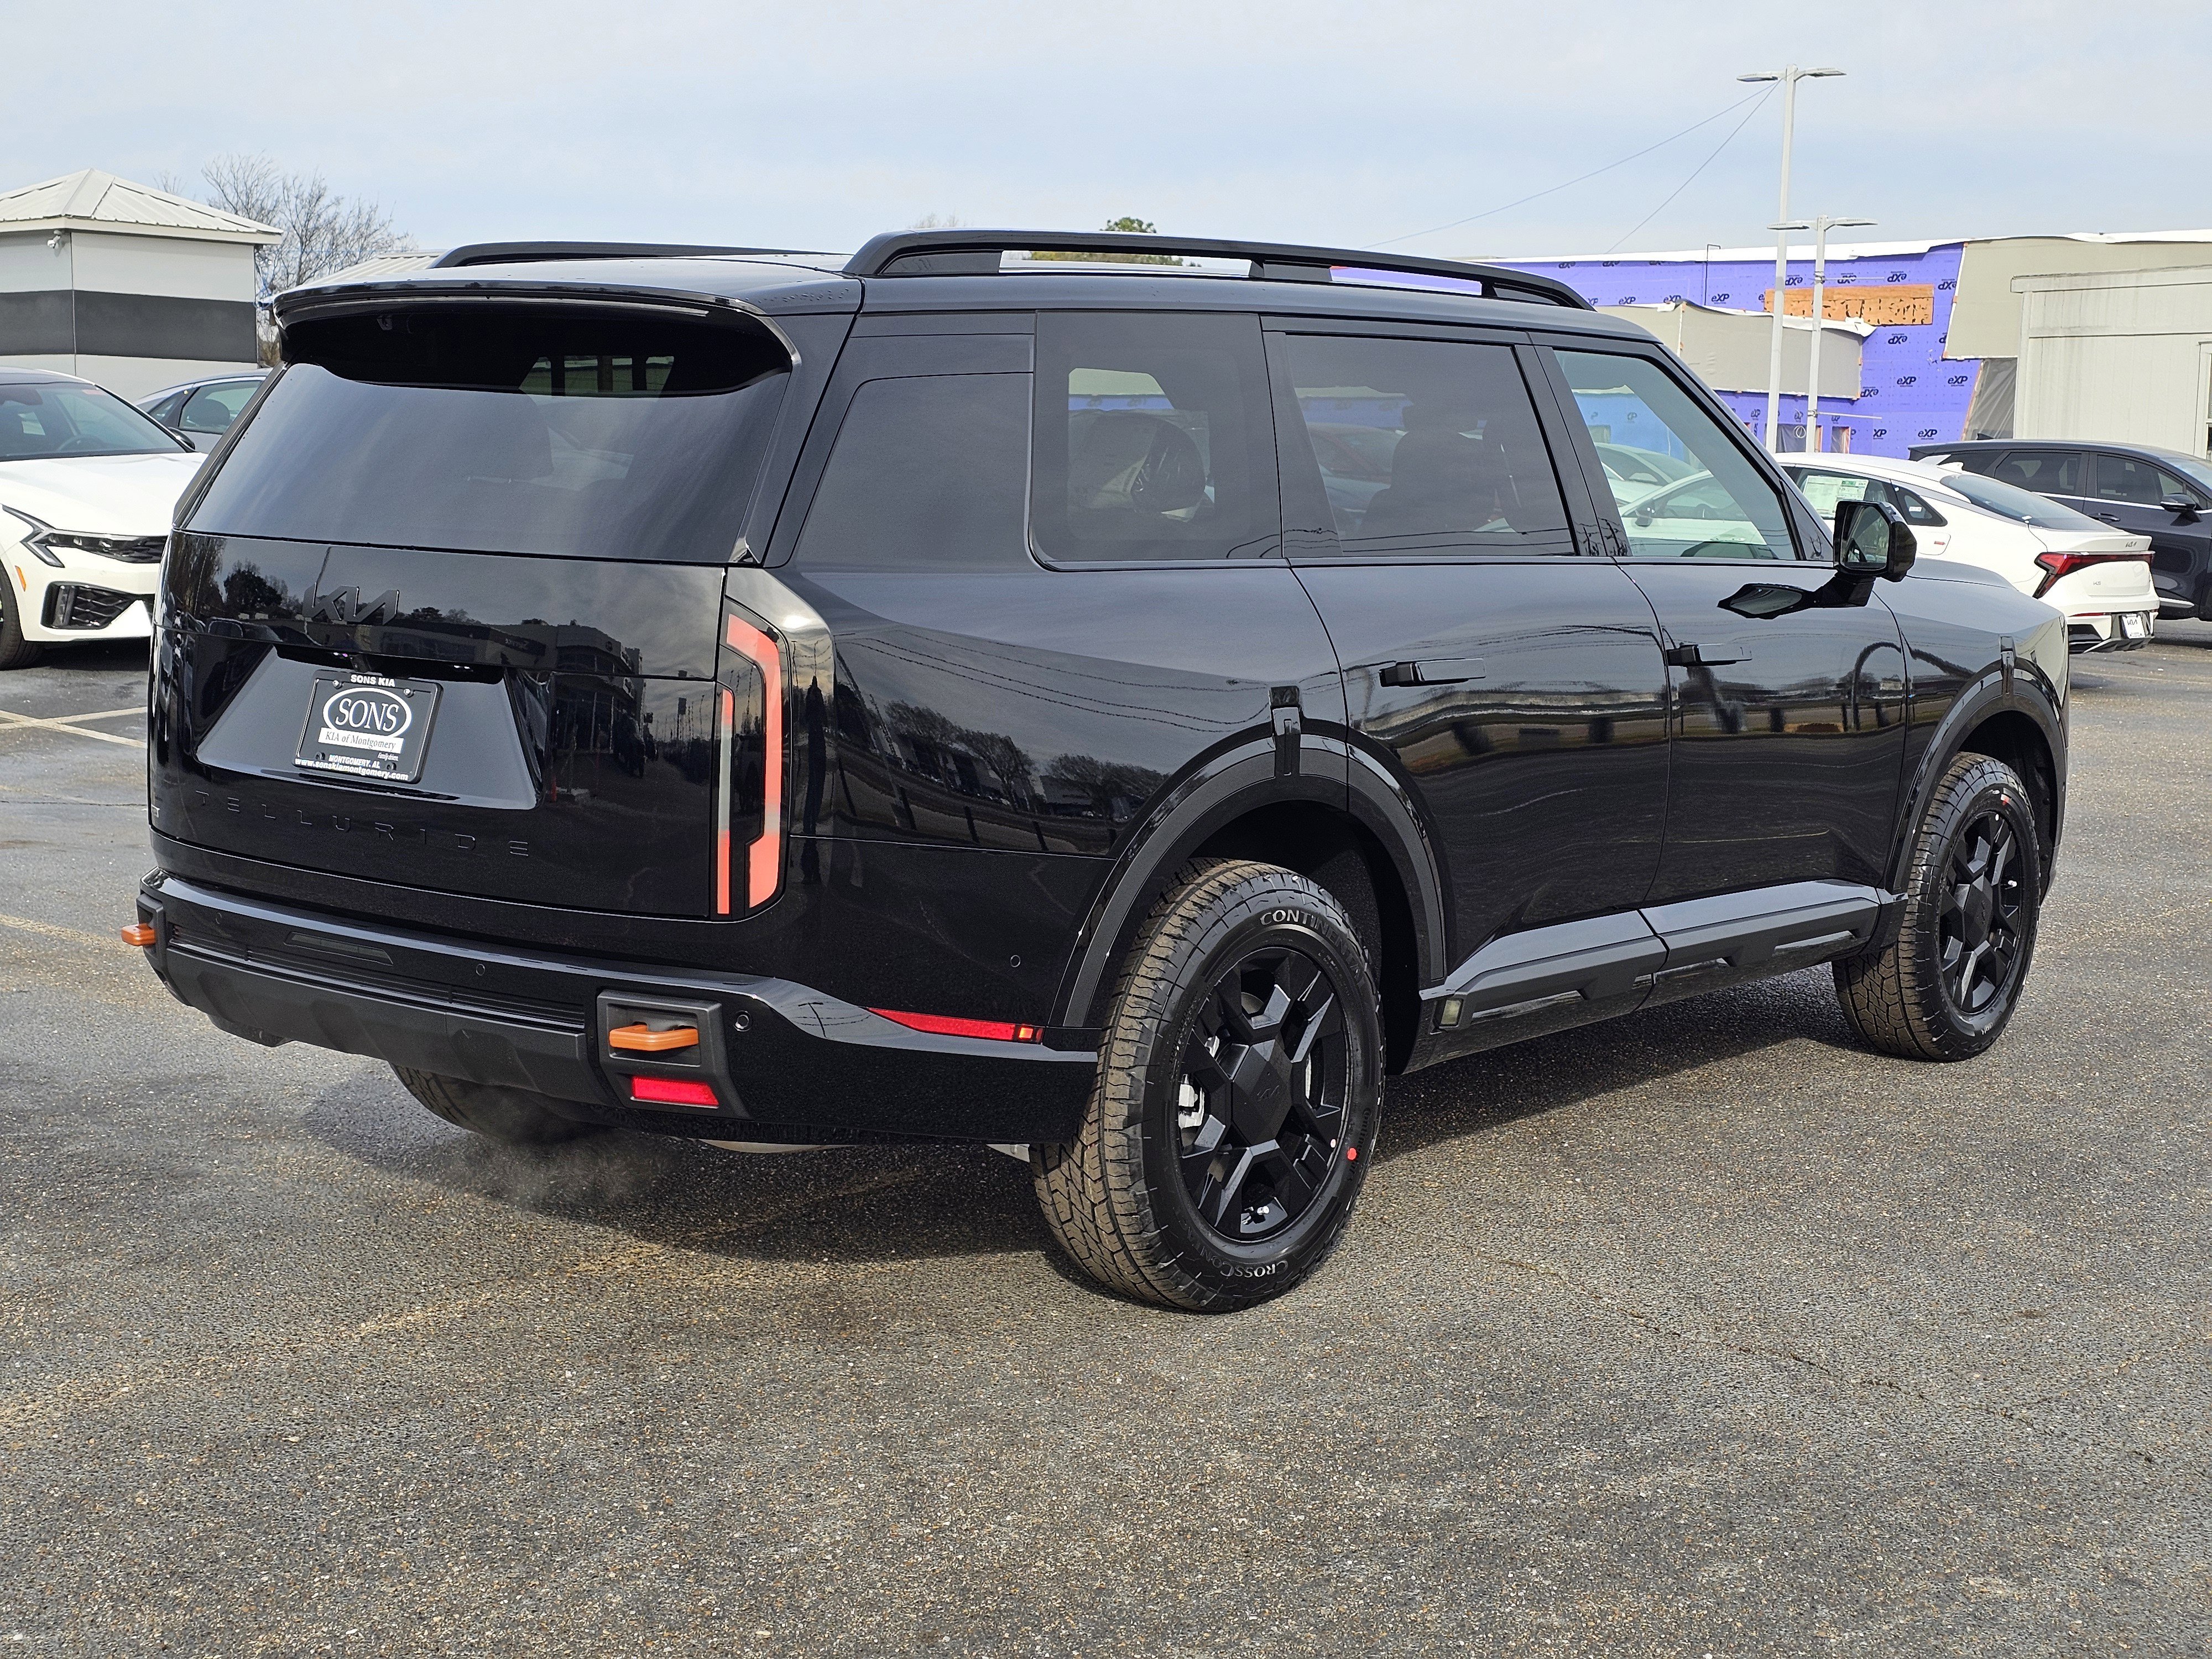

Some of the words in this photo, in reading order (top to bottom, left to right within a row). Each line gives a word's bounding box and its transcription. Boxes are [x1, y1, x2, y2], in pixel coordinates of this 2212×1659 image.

[1785, 276, 1803, 285] eXP
[1887, 273, 1907, 282] eXP
[1619, 296, 1636, 305] eXP
[1711, 294, 1730, 302] eXP
[1887, 335, 1907, 344] eXP
[1897, 376, 1916, 385] eXP
[1947, 375, 1968, 384] eXP
[1874, 429, 1887, 437] XP
[1917, 429, 1938, 437] eXP
[351, 674, 376, 685] SONS
[378, 677, 395, 687] KIA
[335, 698, 399, 732] SONS
[325, 731, 339, 742] KIA
[341, 734, 351, 743] of
[351, 734, 397, 752] Montgomery
[372, 760, 380, 769] AL
[195, 790, 529, 857] TELLURIDE
